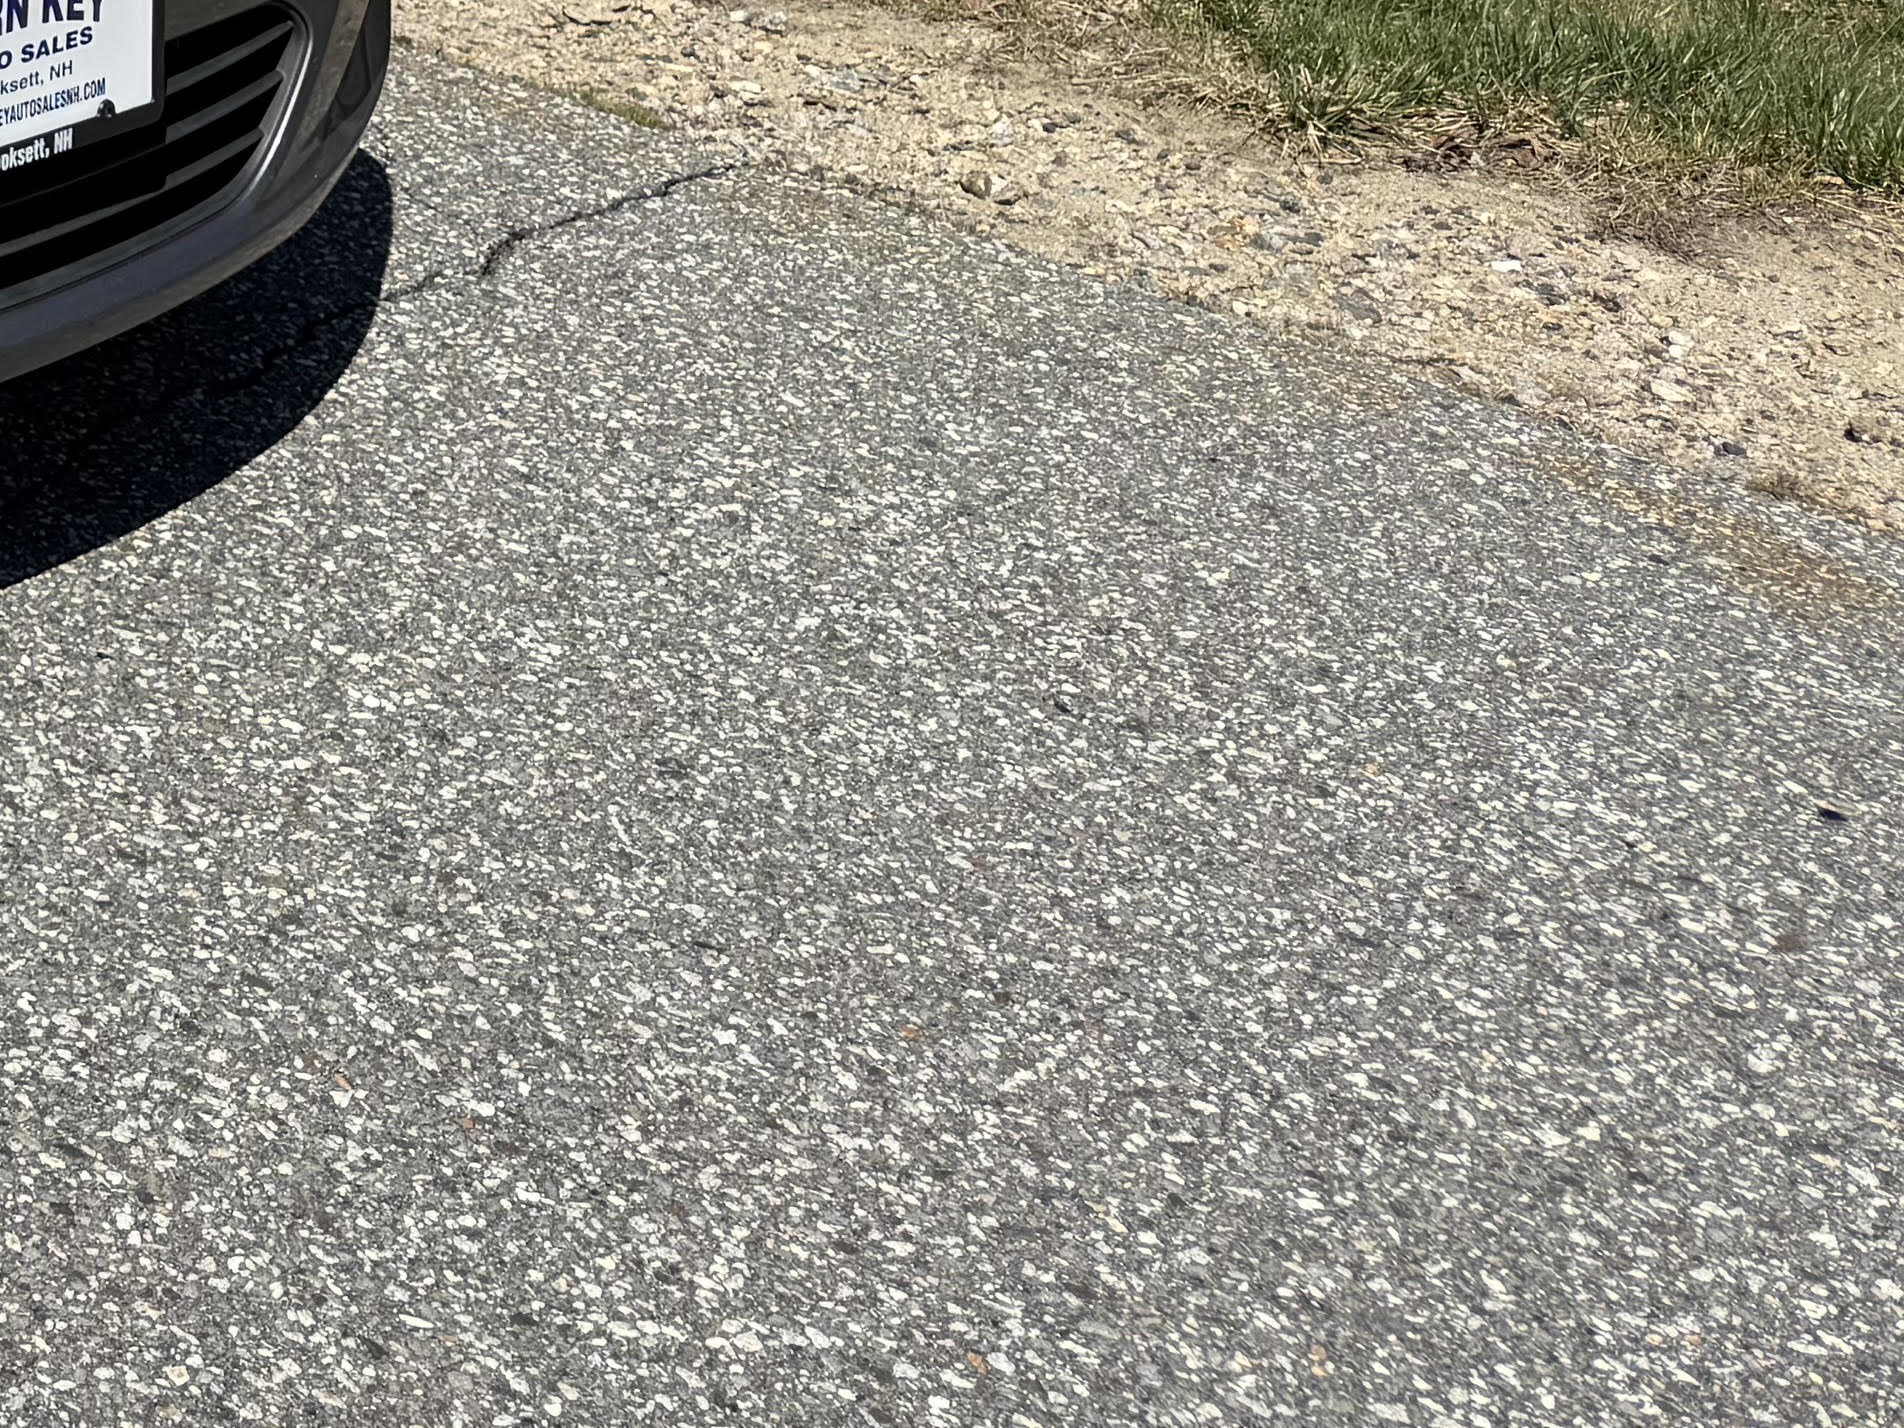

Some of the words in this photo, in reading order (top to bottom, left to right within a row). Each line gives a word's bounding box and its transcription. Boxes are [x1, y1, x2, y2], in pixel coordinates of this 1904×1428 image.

[21, 26, 93, 64] SALES
[50, 60, 73, 81] NH
[54, 128, 73, 153] NH
